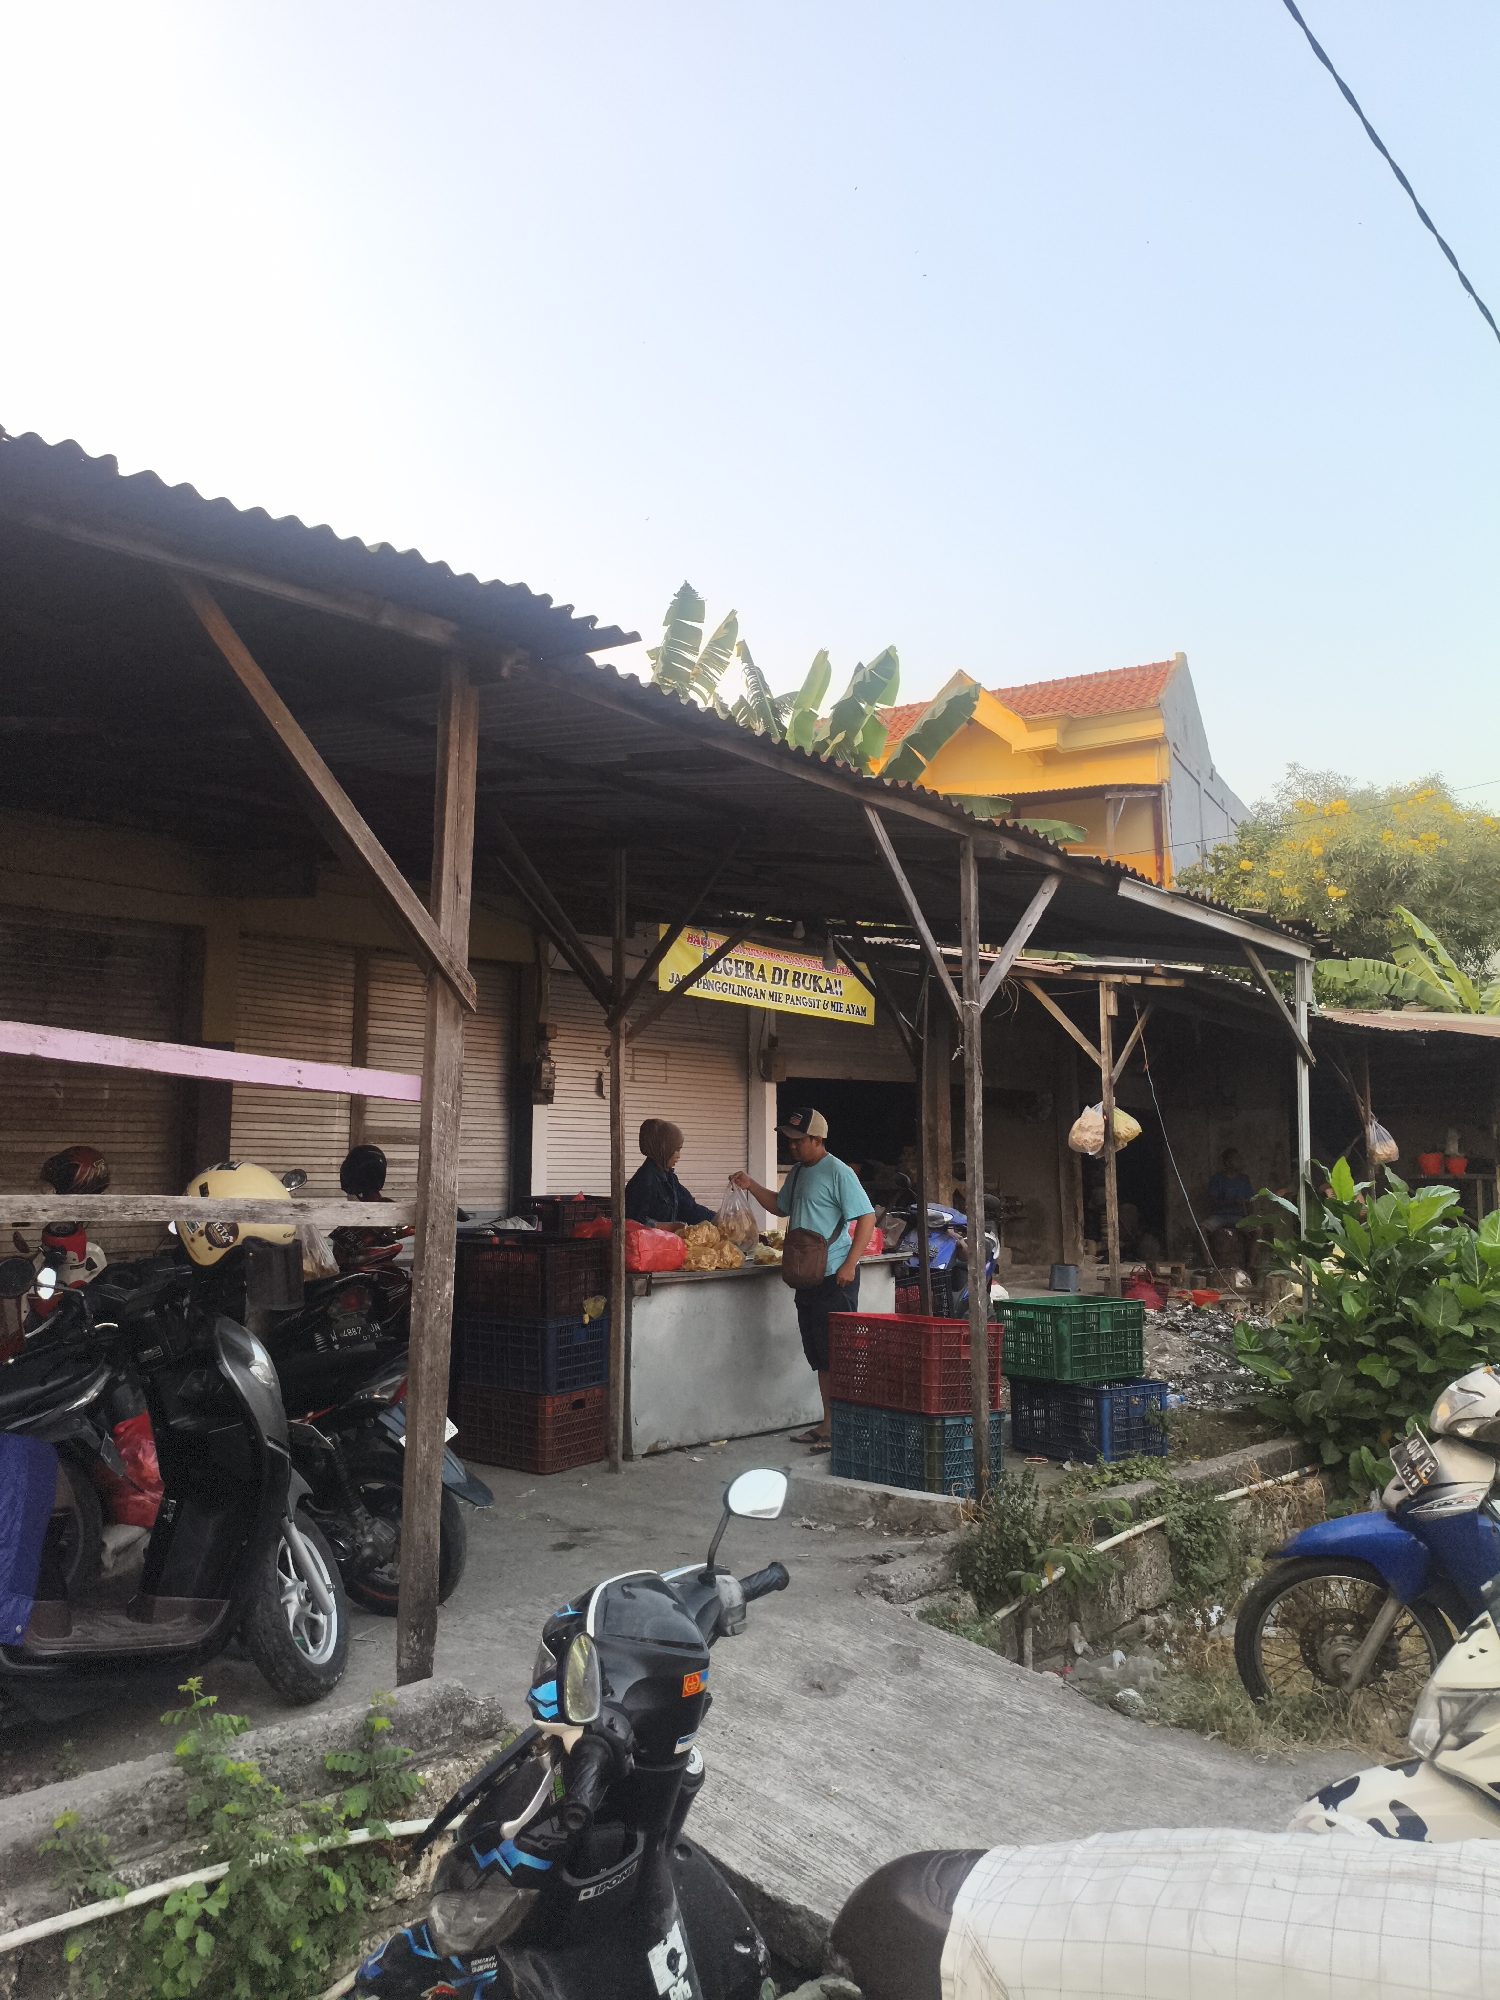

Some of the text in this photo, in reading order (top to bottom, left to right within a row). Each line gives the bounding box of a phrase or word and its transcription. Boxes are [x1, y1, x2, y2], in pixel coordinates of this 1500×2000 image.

[697, 979, 766, 1001] PENGGILINGAN
[768, 990, 783, 1004] MIE
[785, 993, 821, 1010] PANGSIT
[822, 999, 829, 1011] &
[830, 1000, 844, 1014] MIE
[845, 1003, 867, 1017] AYAM
[770, 966, 789, 987] DI
[791, 970, 843, 997] BUKA!!
